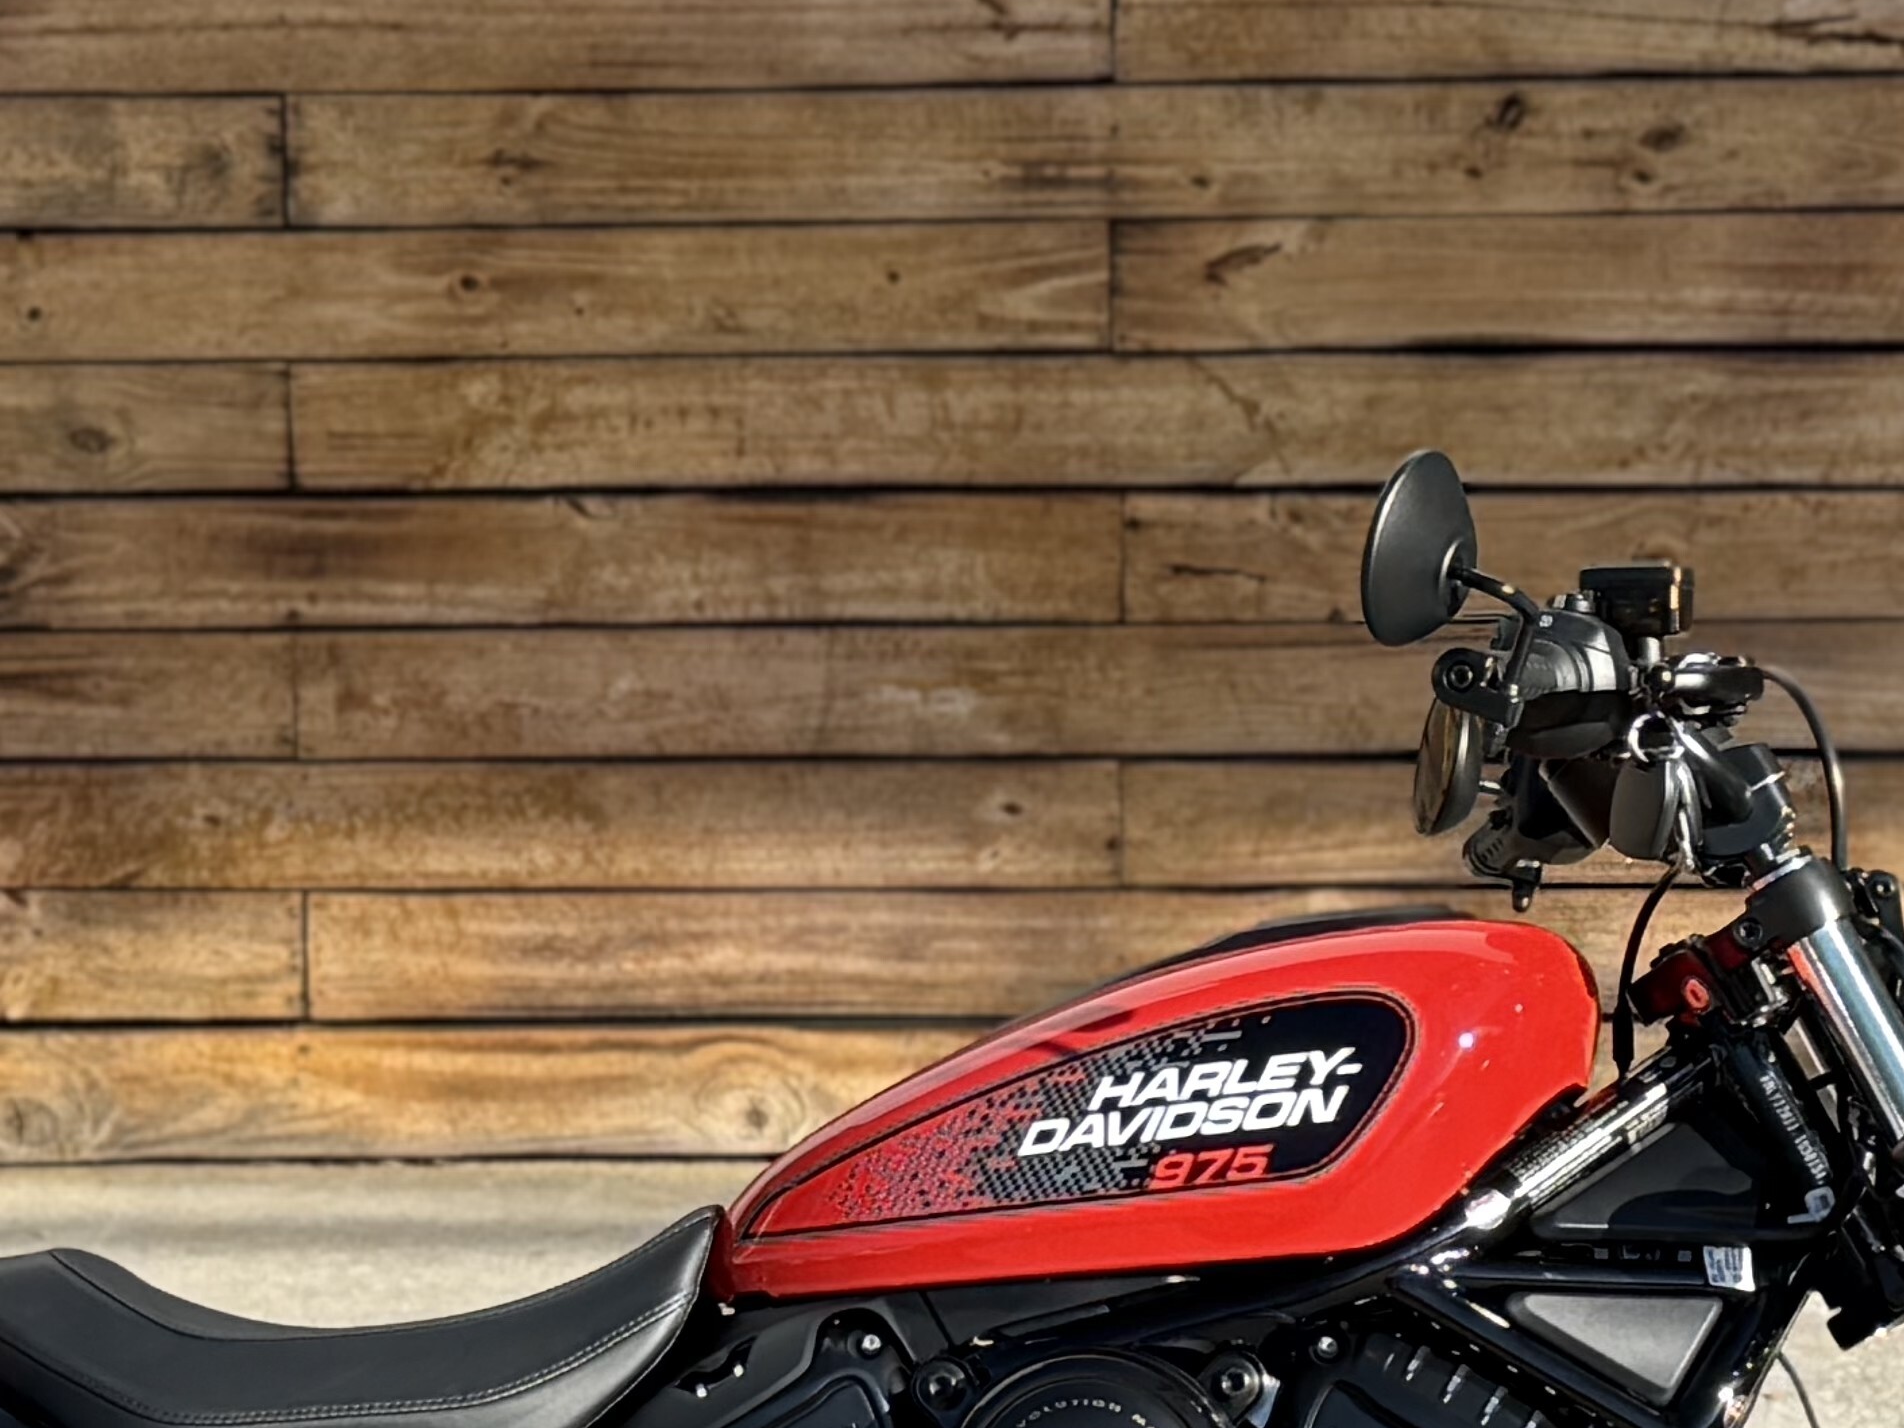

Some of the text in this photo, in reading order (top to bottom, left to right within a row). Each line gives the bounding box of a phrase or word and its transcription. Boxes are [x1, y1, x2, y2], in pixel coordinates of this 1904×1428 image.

[1088, 1046, 1363, 1111] HARLEY-
[1017, 1085, 1350, 1157] DAVIDSON
[1149, 1144, 1275, 1189] 975
